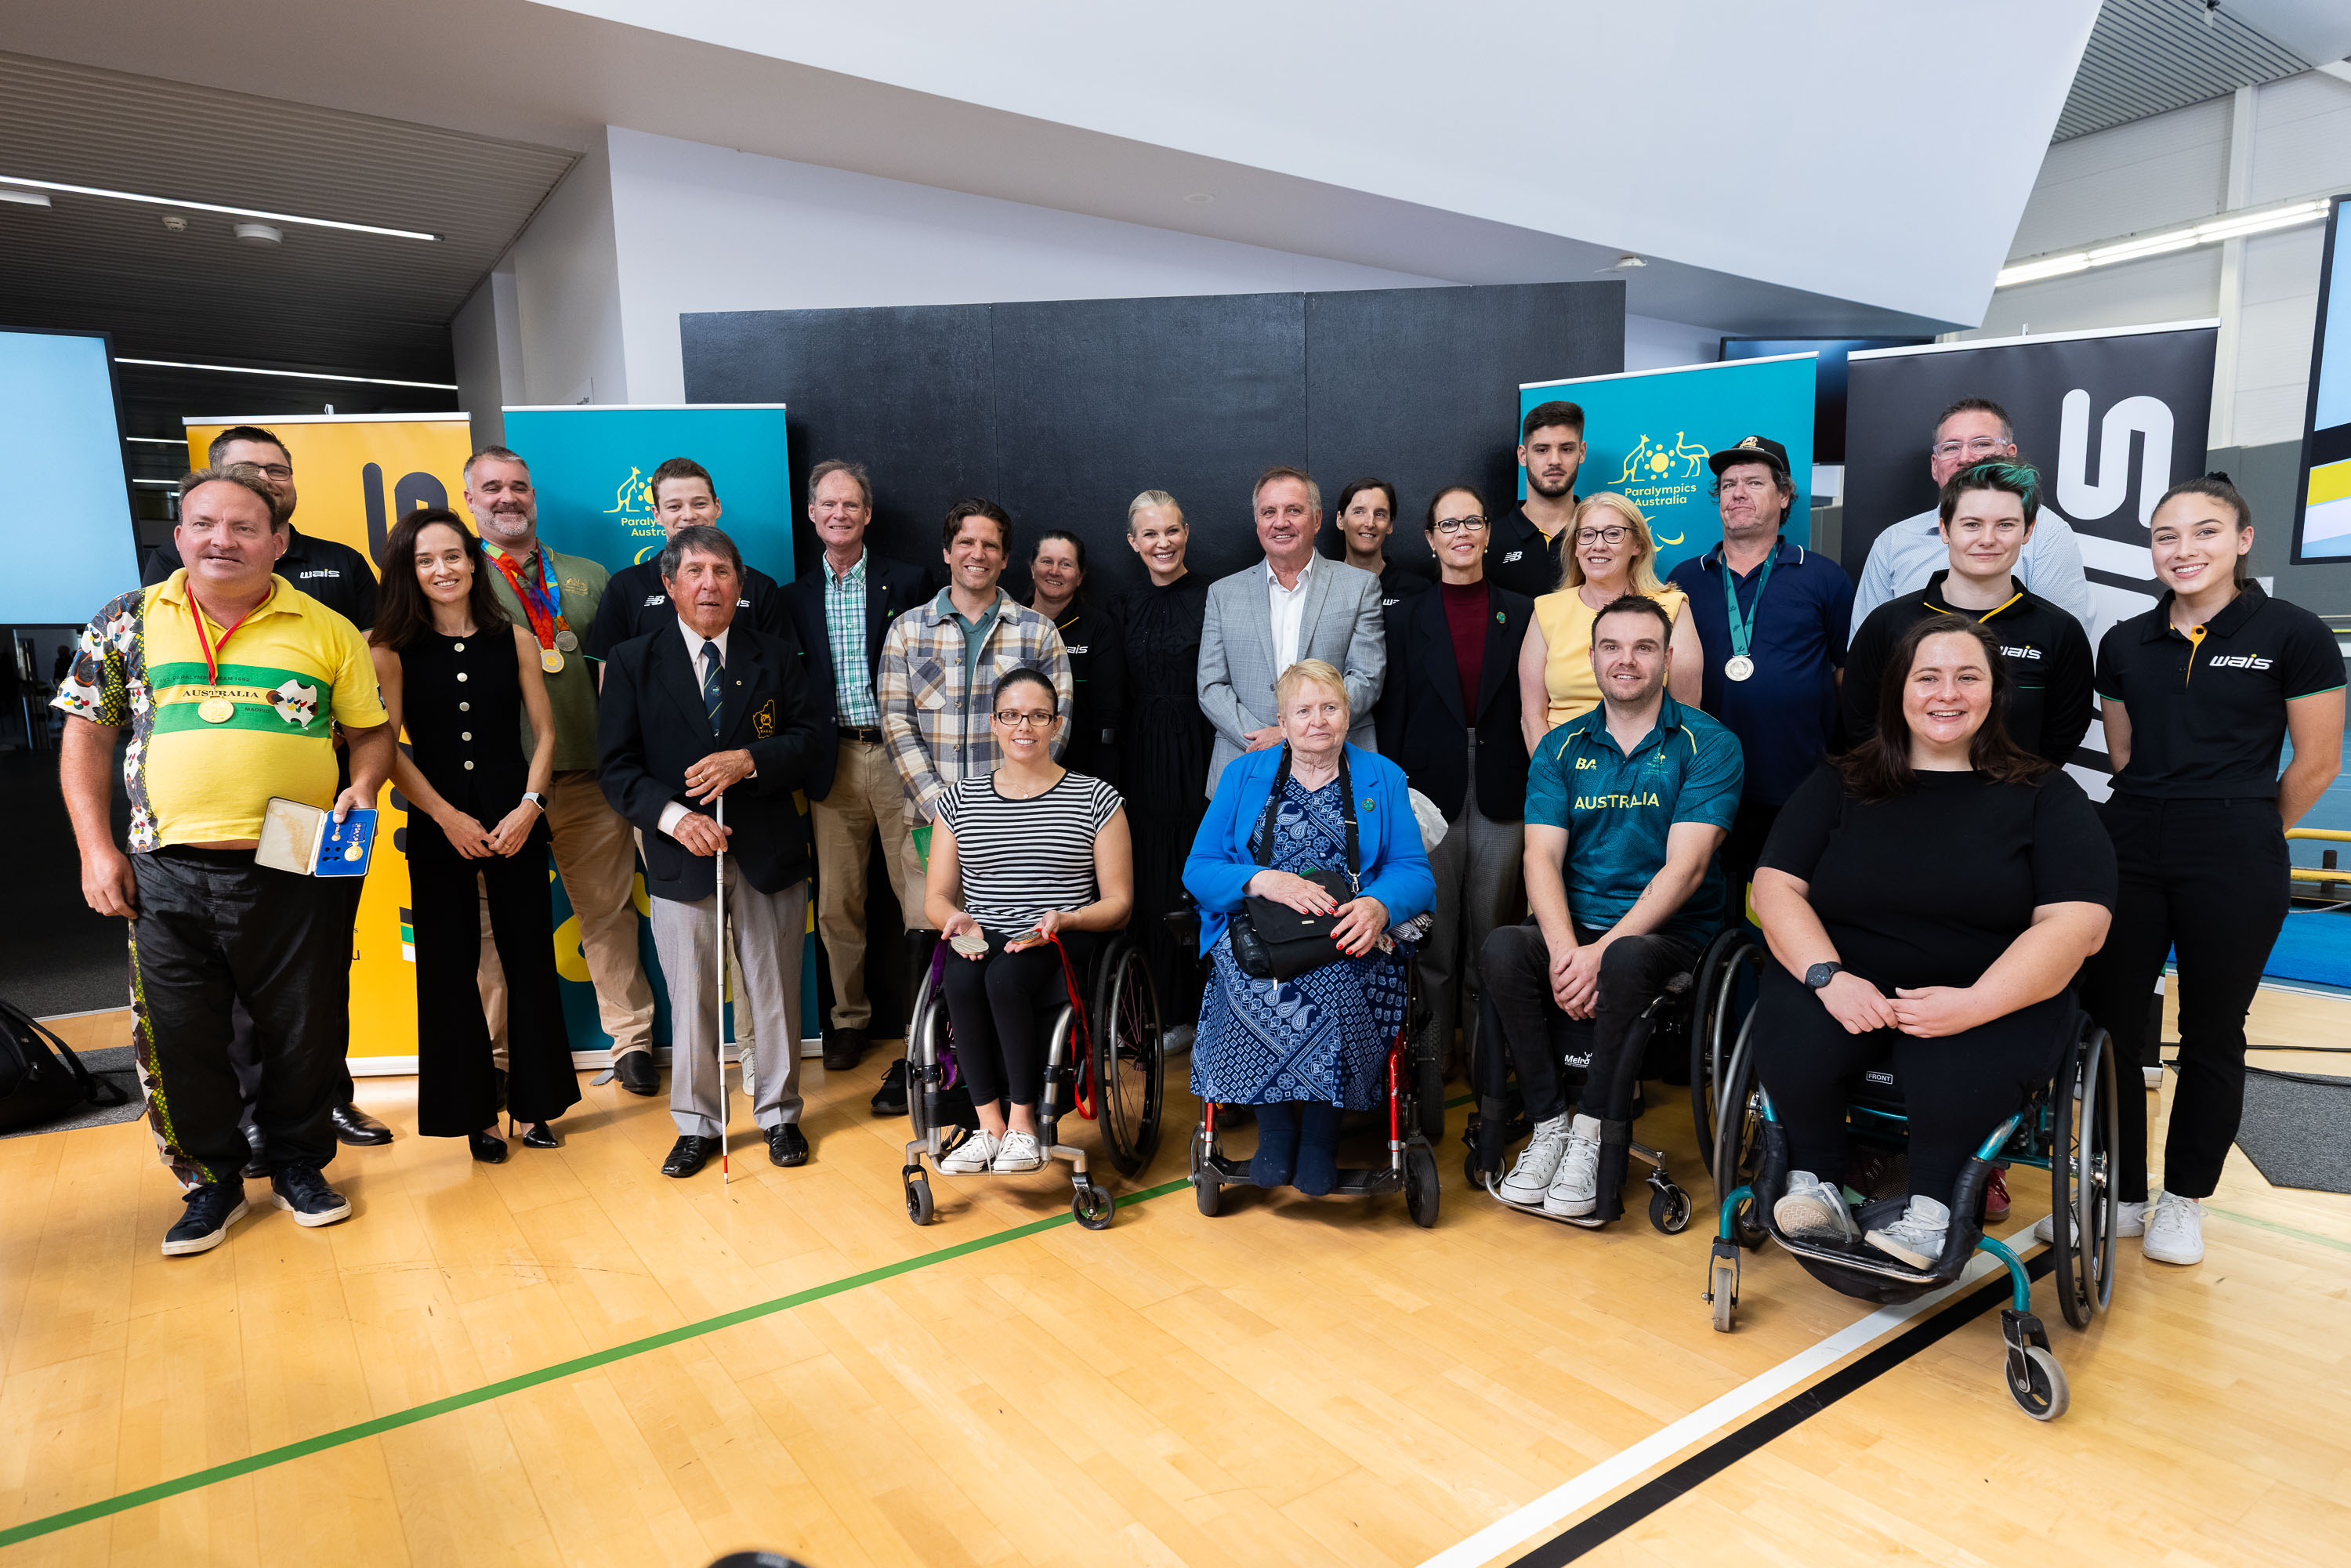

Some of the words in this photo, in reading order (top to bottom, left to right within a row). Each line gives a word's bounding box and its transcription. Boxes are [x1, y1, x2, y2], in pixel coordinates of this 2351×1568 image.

[1625, 483, 1697, 497] Paralympics
[1635, 494, 1686, 506] Australia
[621, 516, 656, 527] Paraly
[631, 527, 666, 537] Austra
[299, 568, 340, 579] wais
[737, 597, 751, 607] is
[1066, 644, 1089, 654] ais
[2208, 654, 2273, 670] wais
[183, 690, 259, 698] AUSTRALIA
[1574, 791, 1660, 809] AUSTRALIA
[1868, 1074, 1891, 1082] FRONT
